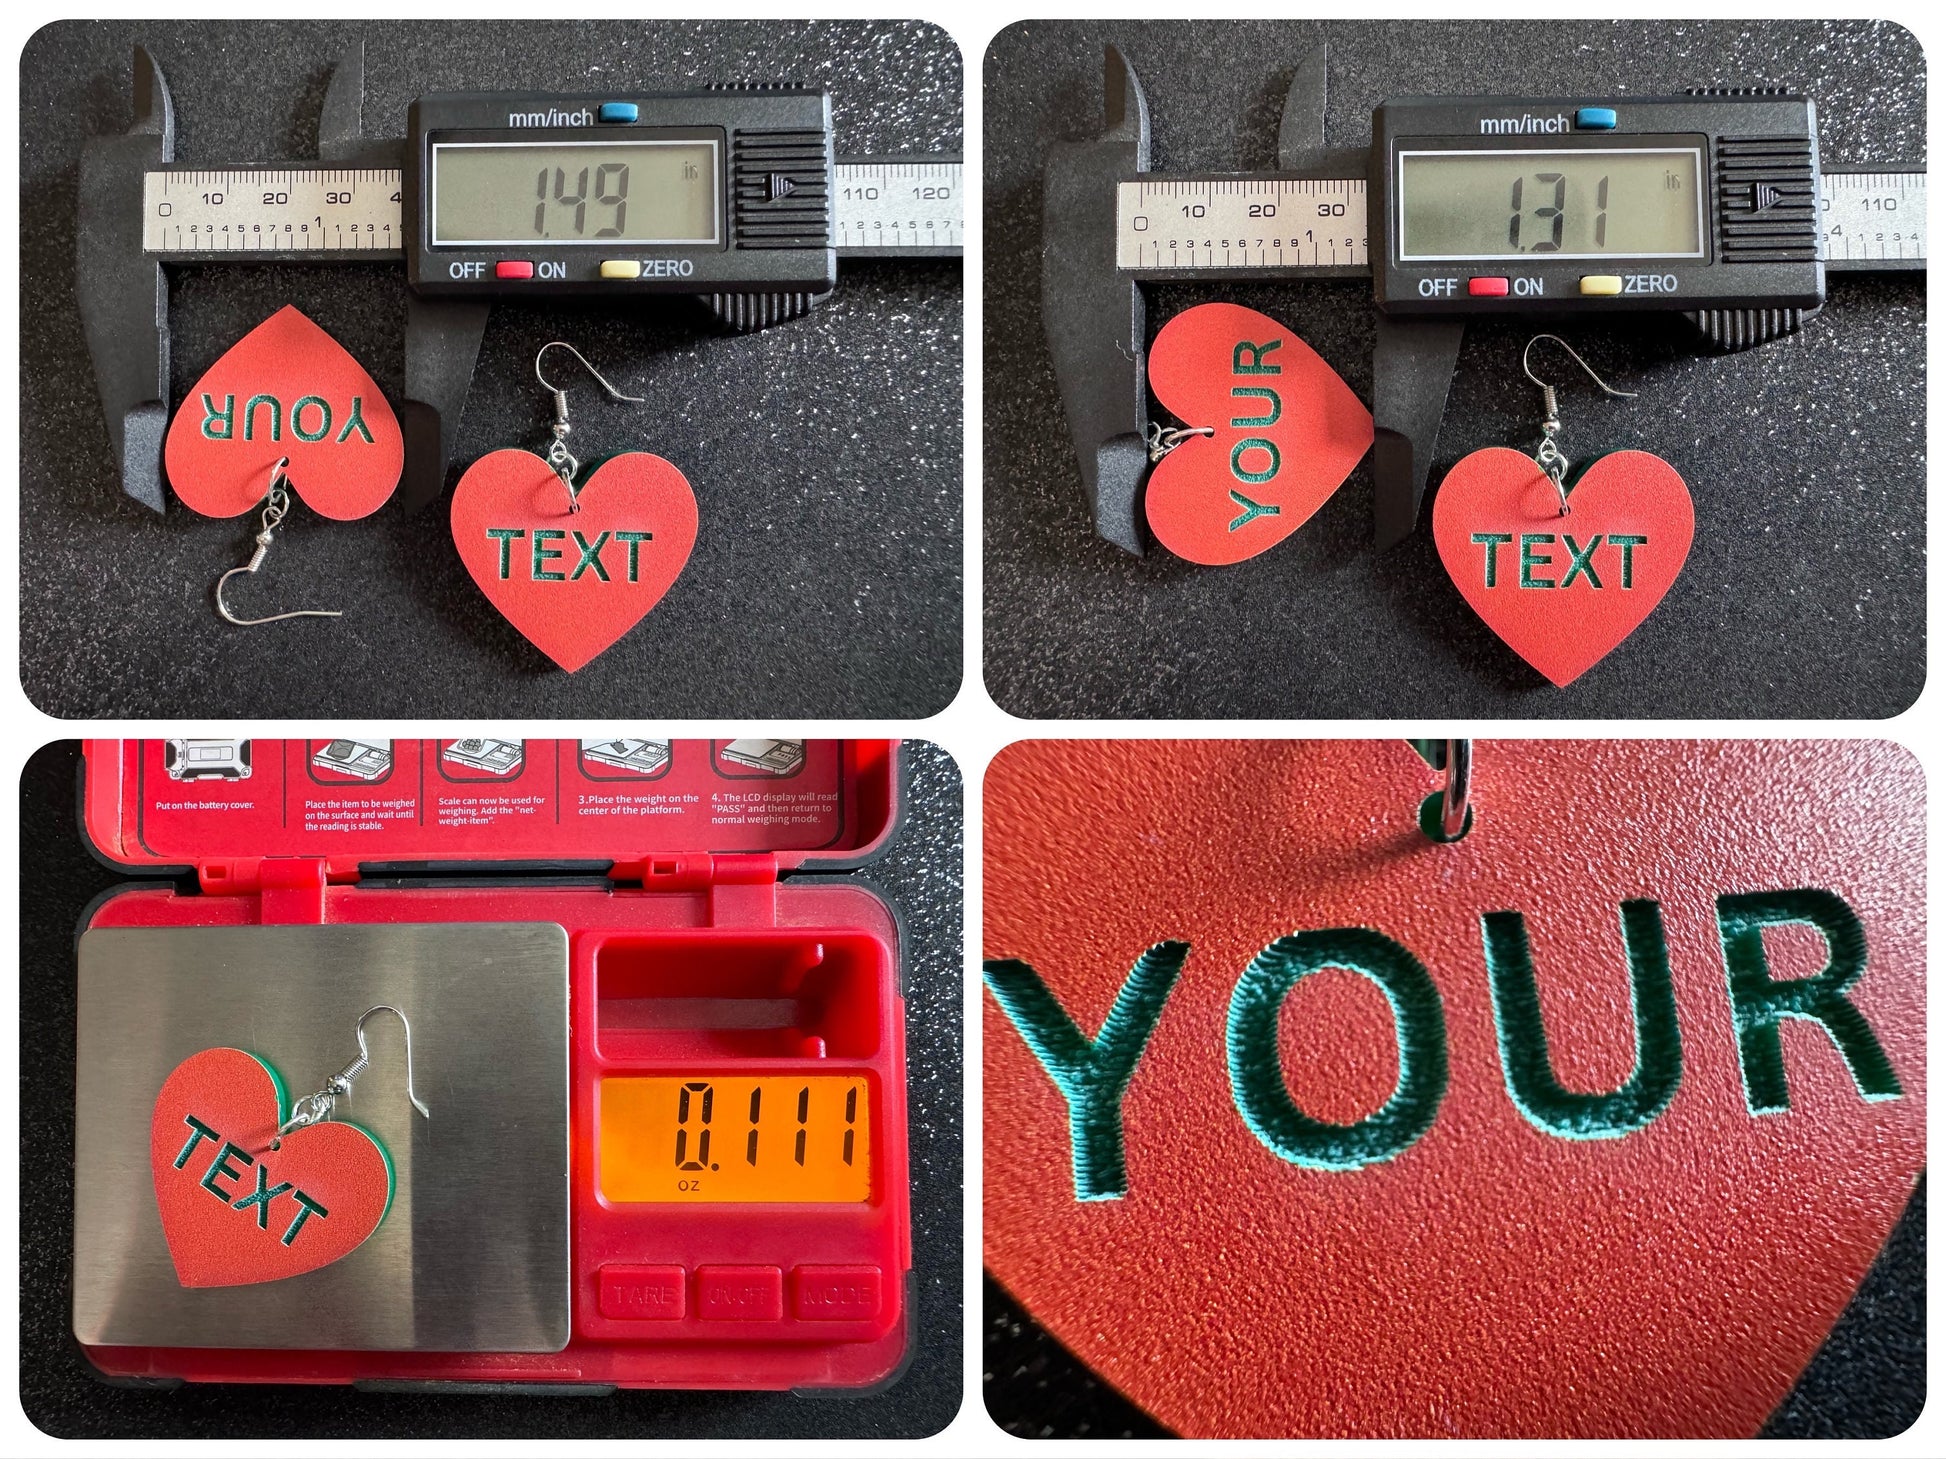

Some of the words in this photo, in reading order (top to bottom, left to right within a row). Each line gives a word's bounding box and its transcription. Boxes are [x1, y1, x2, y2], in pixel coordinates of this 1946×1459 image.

[509, 108, 593, 127] mm/inch
[1480, 115, 1570, 133] mm/inch
[203, 193, 223, 204] 10
[263, 193, 287, 204] 20
[326, 192, 351, 204] 30
[390, 192, 402, 203] 4
[534, 163, 630, 237] 1.49
[844, 188, 878, 200] 110
[913, 187, 950, 200] 120
[159, 203, 171, 217] 0
[1182, 205, 1205, 218] 10
[1249, 205, 1275, 217] 20
[1318, 204, 1345, 216] 30
[1862, 198, 1896, 211] 110
[1509, 173, 1608, 251] 1.31
[315, 216, 320, 228] 1
[351, 224, 358, 232] 2
[367, 224, 374, 232] 3
[840, 221, 844, 229] 1
[857, 221, 864, 229] 2
[874, 221, 881, 229] 3
[891, 221, 899, 229] 4
[909, 221, 916, 229] 5
[944, 221, 950, 229] 7
[1134, 216, 1148, 231] 0
[1153, 240, 1157, 248] 1
[1170, 240, 1176, 248] 2
[1187, 240, 1194, 248] 3
[1222, 240, 1229, 248] 5
[1256, 239, 1263, 247] 7
[1273, 239, 1280, 247] 8
[1291, 239, 1298, 247] 9
[1306, 230, 1312, 242] 1
[1831, 224, 1842, 236] 4
[1859, 233, 1863, 241] 1
[1876, 233, 1883, 241] 2
[1893, 233, 1900, 241] 3
[1911, 233, 1918, 241] 4
[449, 262, 485, 279] OFF
[538, 262, 566, 279] ON
[643, 260, 693, 278] ZERO
[1418, 278, 1457, 297] OFF
[1514, 278, 1543, 296] ON
[1625, 274, 1678, 293] ZERO
[200, 394, 376, 444] YOUR
[1229, 338, 1283, 533] YOUR
[486, 528, 653, 583] TEXT
[1471, 533, 1648, 590] TEXT
[327, 800, 340, 808] the
[342, 800, 359, 808] item
[383, 799, 415, 809] weighed
[439, 797, 461, 805] Scale
[511, 796, 531, 804] used
[533, 796, 545, 804] for
[616, 795, 631, 804] the
[634, 794, 667, 805] weight
[669, 795, 680, 803] on
[683, 794, 699, 802] the
[712, 793, 720, 801] 4.
[724, 794, 740, 802] The
[763, 793, 796, 803] display
[798, 793, 815, 801] will
[199, 801, 228, 811] battery
[439, 807, 478, 816] weighing.
[481, 807, 497, 815] Add
[579, 807, 609, 815] center
[611, 806, 621, 814] of
[623, 806, 638, 814] the
[641, 805, 684, 816] platform.
[712, 804, 745, 813] "PASS"
[748, 804, 765, 812] and
[768, 804, 788, 812] then
[332, 811, 359, 819] surface
[396, 810, 414, 818] until
[712, 815, 745, 824] normal
[747, 815, 789, 825] weighing
[792, 814, 820, 823] mode.
[320, 822, 349, 832] reading
[351, 822, 357, 830] is
[359, 822, 384, 830] stable.
[983, 888, 1904, 1203] YOUR
[675, 1083, 856, 1171] 0.111
[173, 1114, 328, 1247] TEXT
